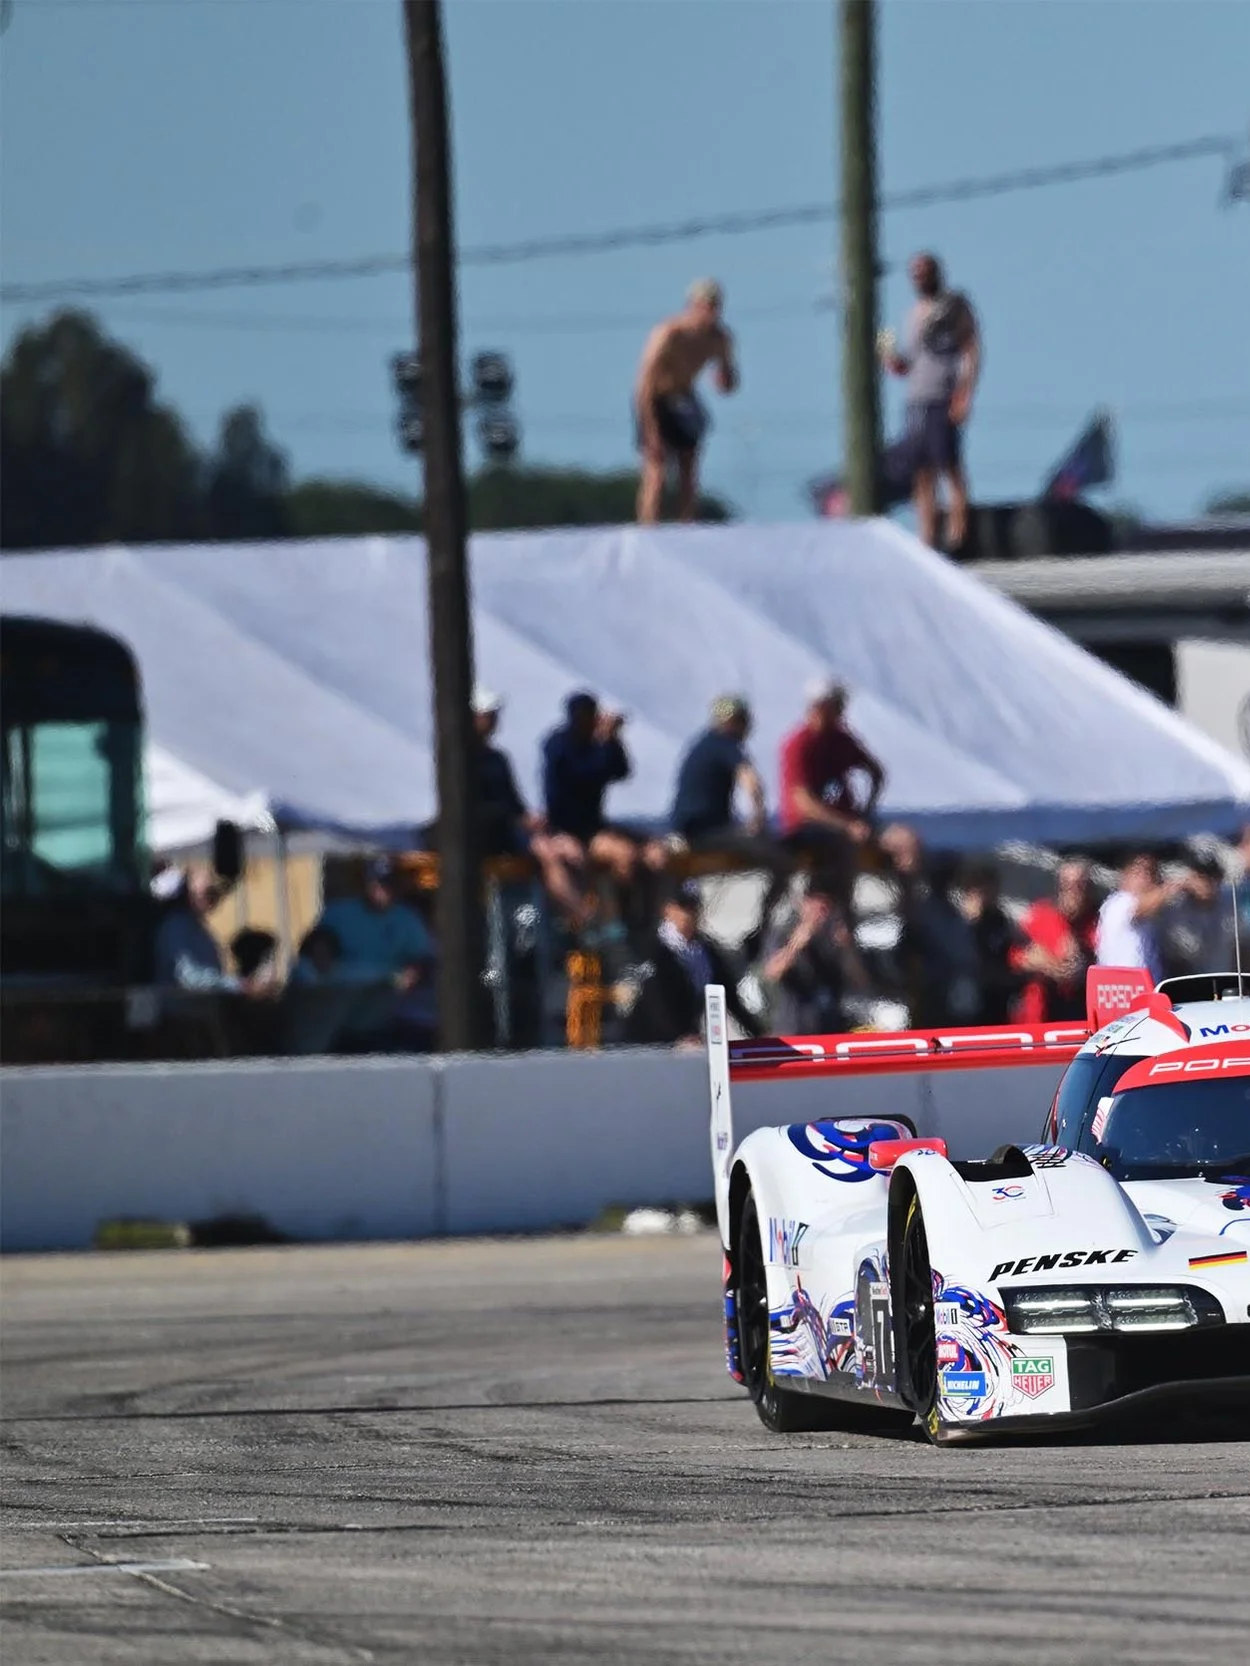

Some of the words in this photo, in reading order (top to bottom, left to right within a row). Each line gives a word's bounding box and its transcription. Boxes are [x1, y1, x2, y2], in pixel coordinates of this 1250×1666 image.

[986, 1249, 1139, 1282] PENSKE
[1014, 1360, 1050, 1373] TAG
[1013, 1375, 1052, 1397] HEUER
